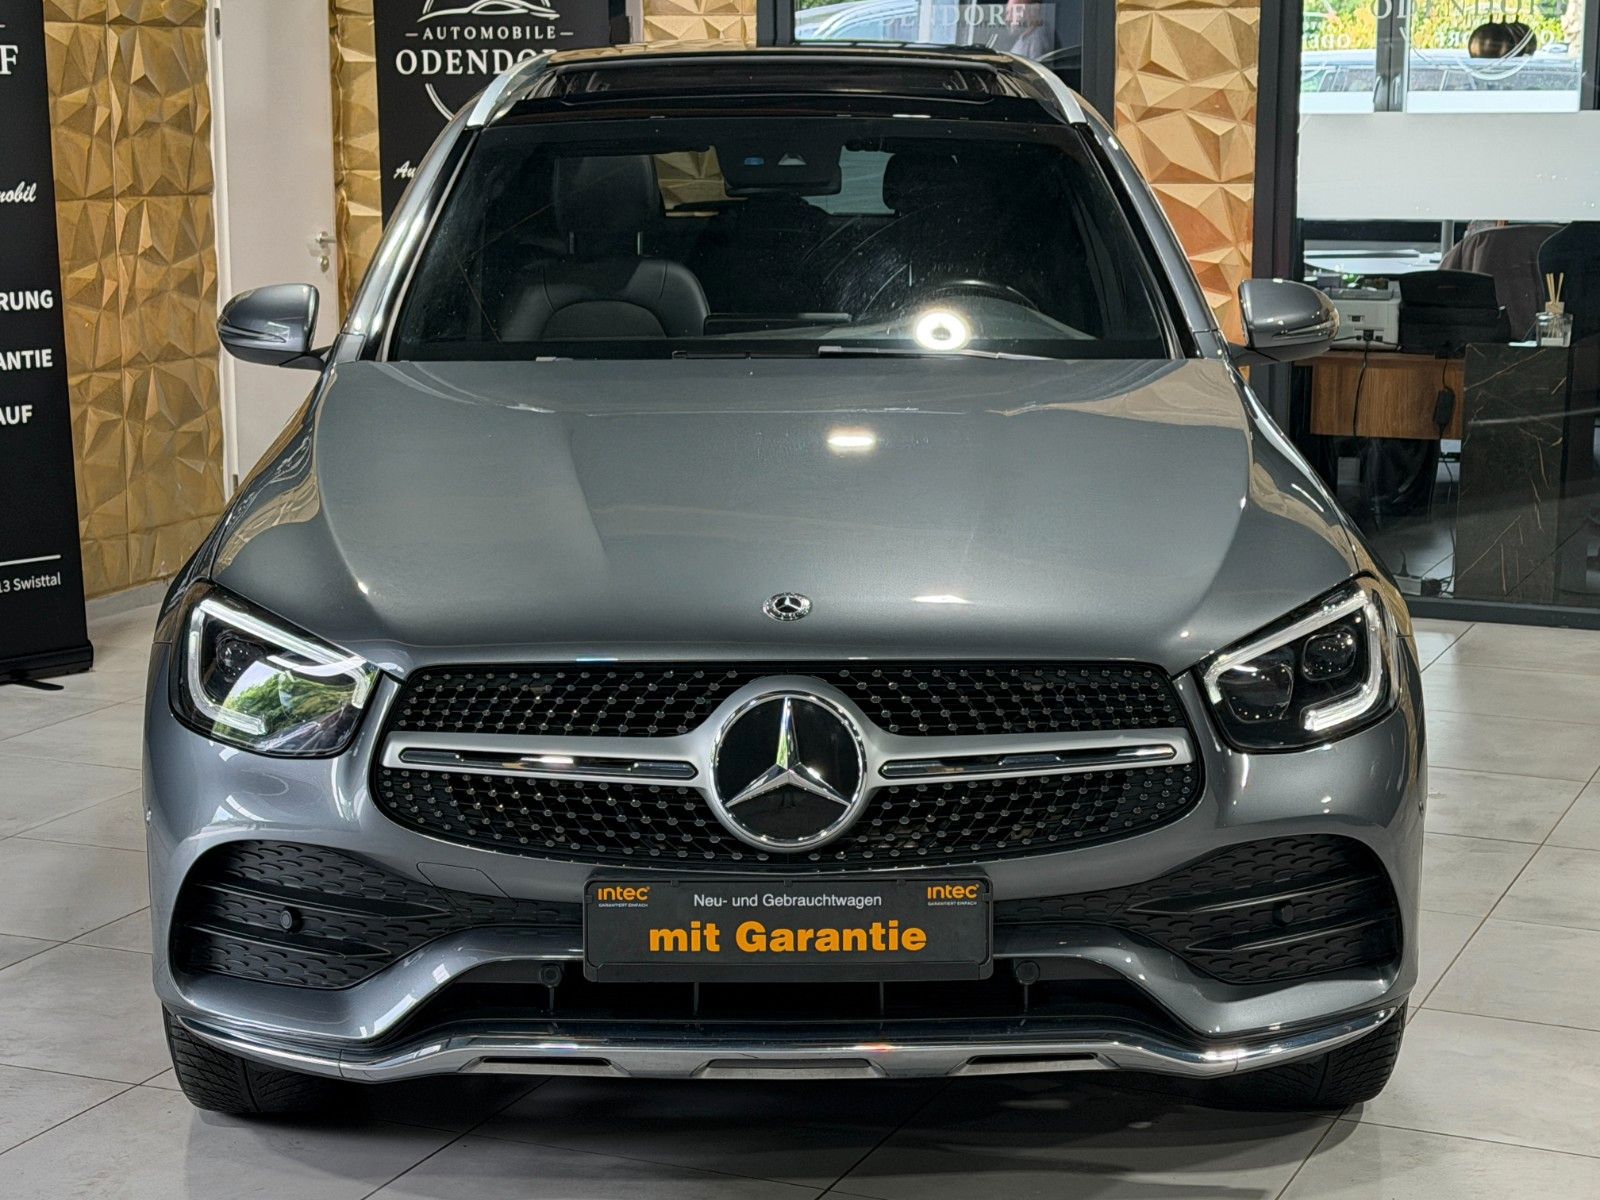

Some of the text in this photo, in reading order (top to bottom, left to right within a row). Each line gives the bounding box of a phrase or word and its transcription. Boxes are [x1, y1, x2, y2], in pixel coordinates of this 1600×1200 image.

[422, 26, 556, 40] AUTOMOBILE
[395, 48, 558, 75] ODEND
[13, 571, 61, 591] Swisttal
[694, 893, 881, 909] Neu- und Gebrauchtwagen
[649, 920, 927, 952] mit Garantie
